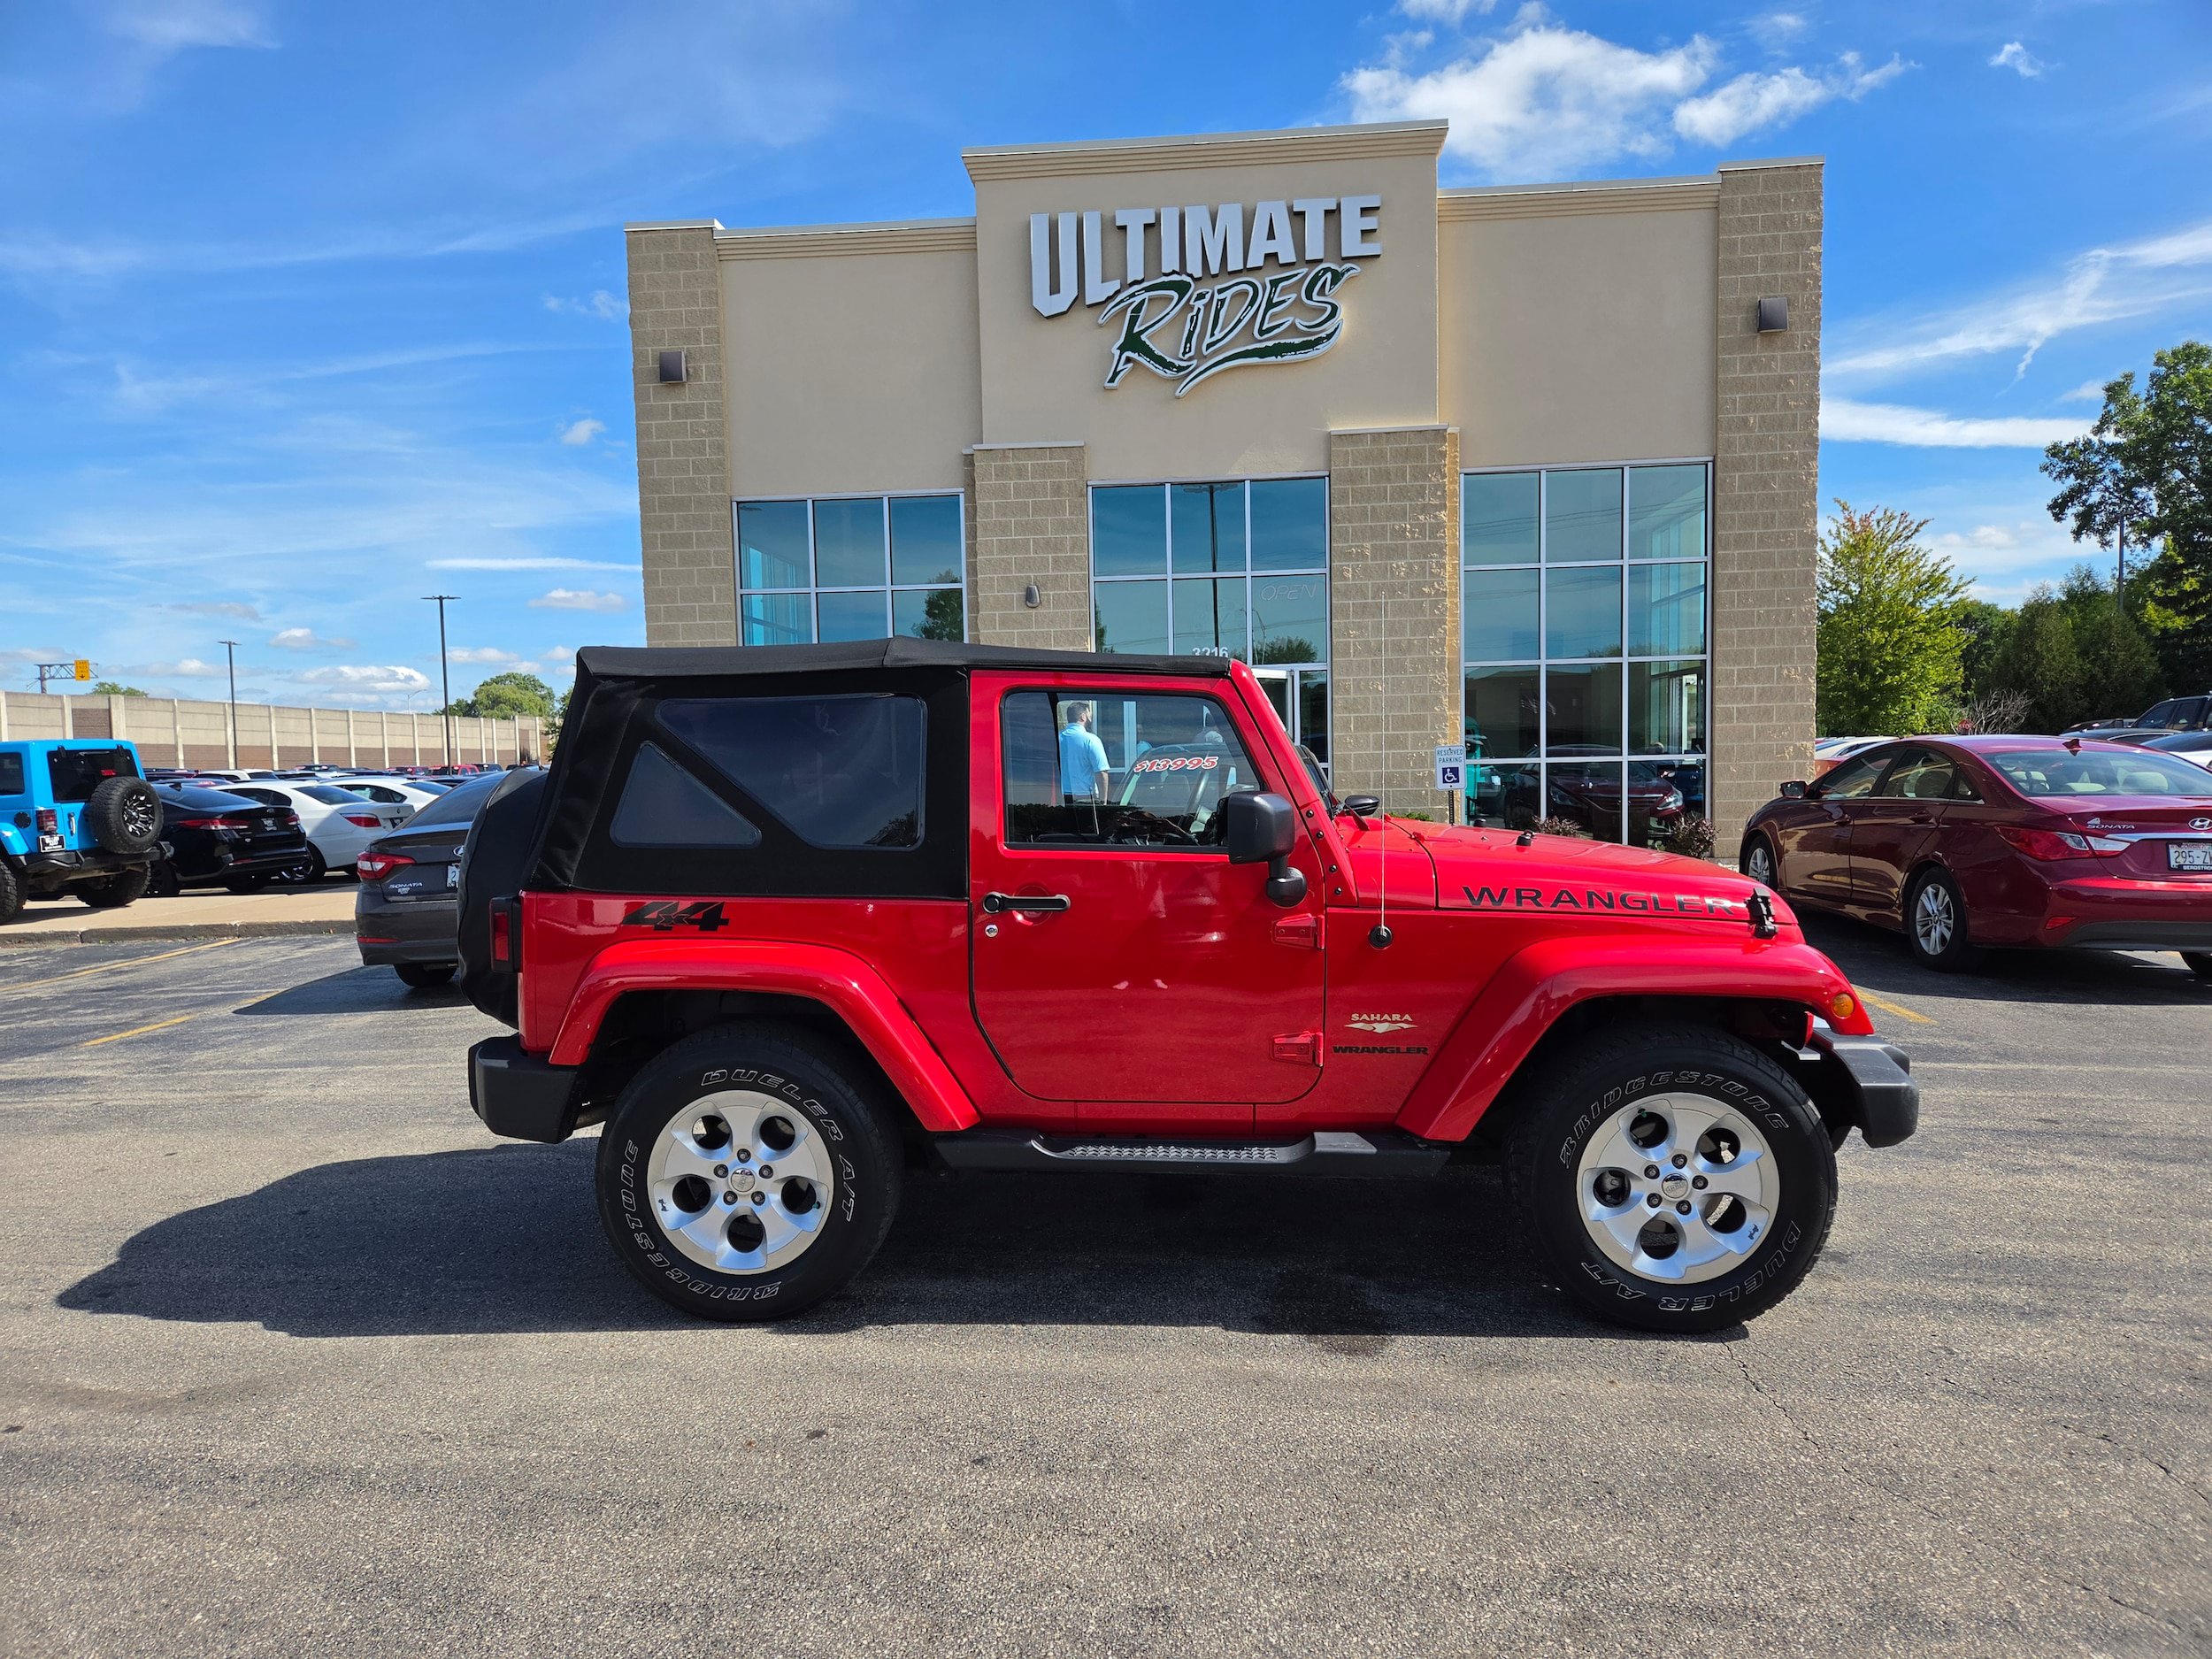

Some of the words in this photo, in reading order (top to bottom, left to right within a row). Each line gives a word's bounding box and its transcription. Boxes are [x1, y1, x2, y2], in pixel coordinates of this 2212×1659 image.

[1030, 195, 1382, 319] ULTIMATE
[1260, 584, 1317, 601] OPEN
[1133, 756, 1219, 773] $13995
[1463, 886, 1737, 916] WRANGLER
[1351, 1013, 1413, 1022] SAHARA
[1333, 1046, 1430, 1056] WRANGLER
[1559, 1070, 1789, 1169] BRIDGESTONE
[701, 1068, 844, 1141] DUELER
[839, 1154, 856, 1222] A/T
[619, 1139, 782, 1302] BRIDGESTONE
[1581, 1261, 1647, 1301] A/T
[1657, 1220, 1801, 1311] DUELER
